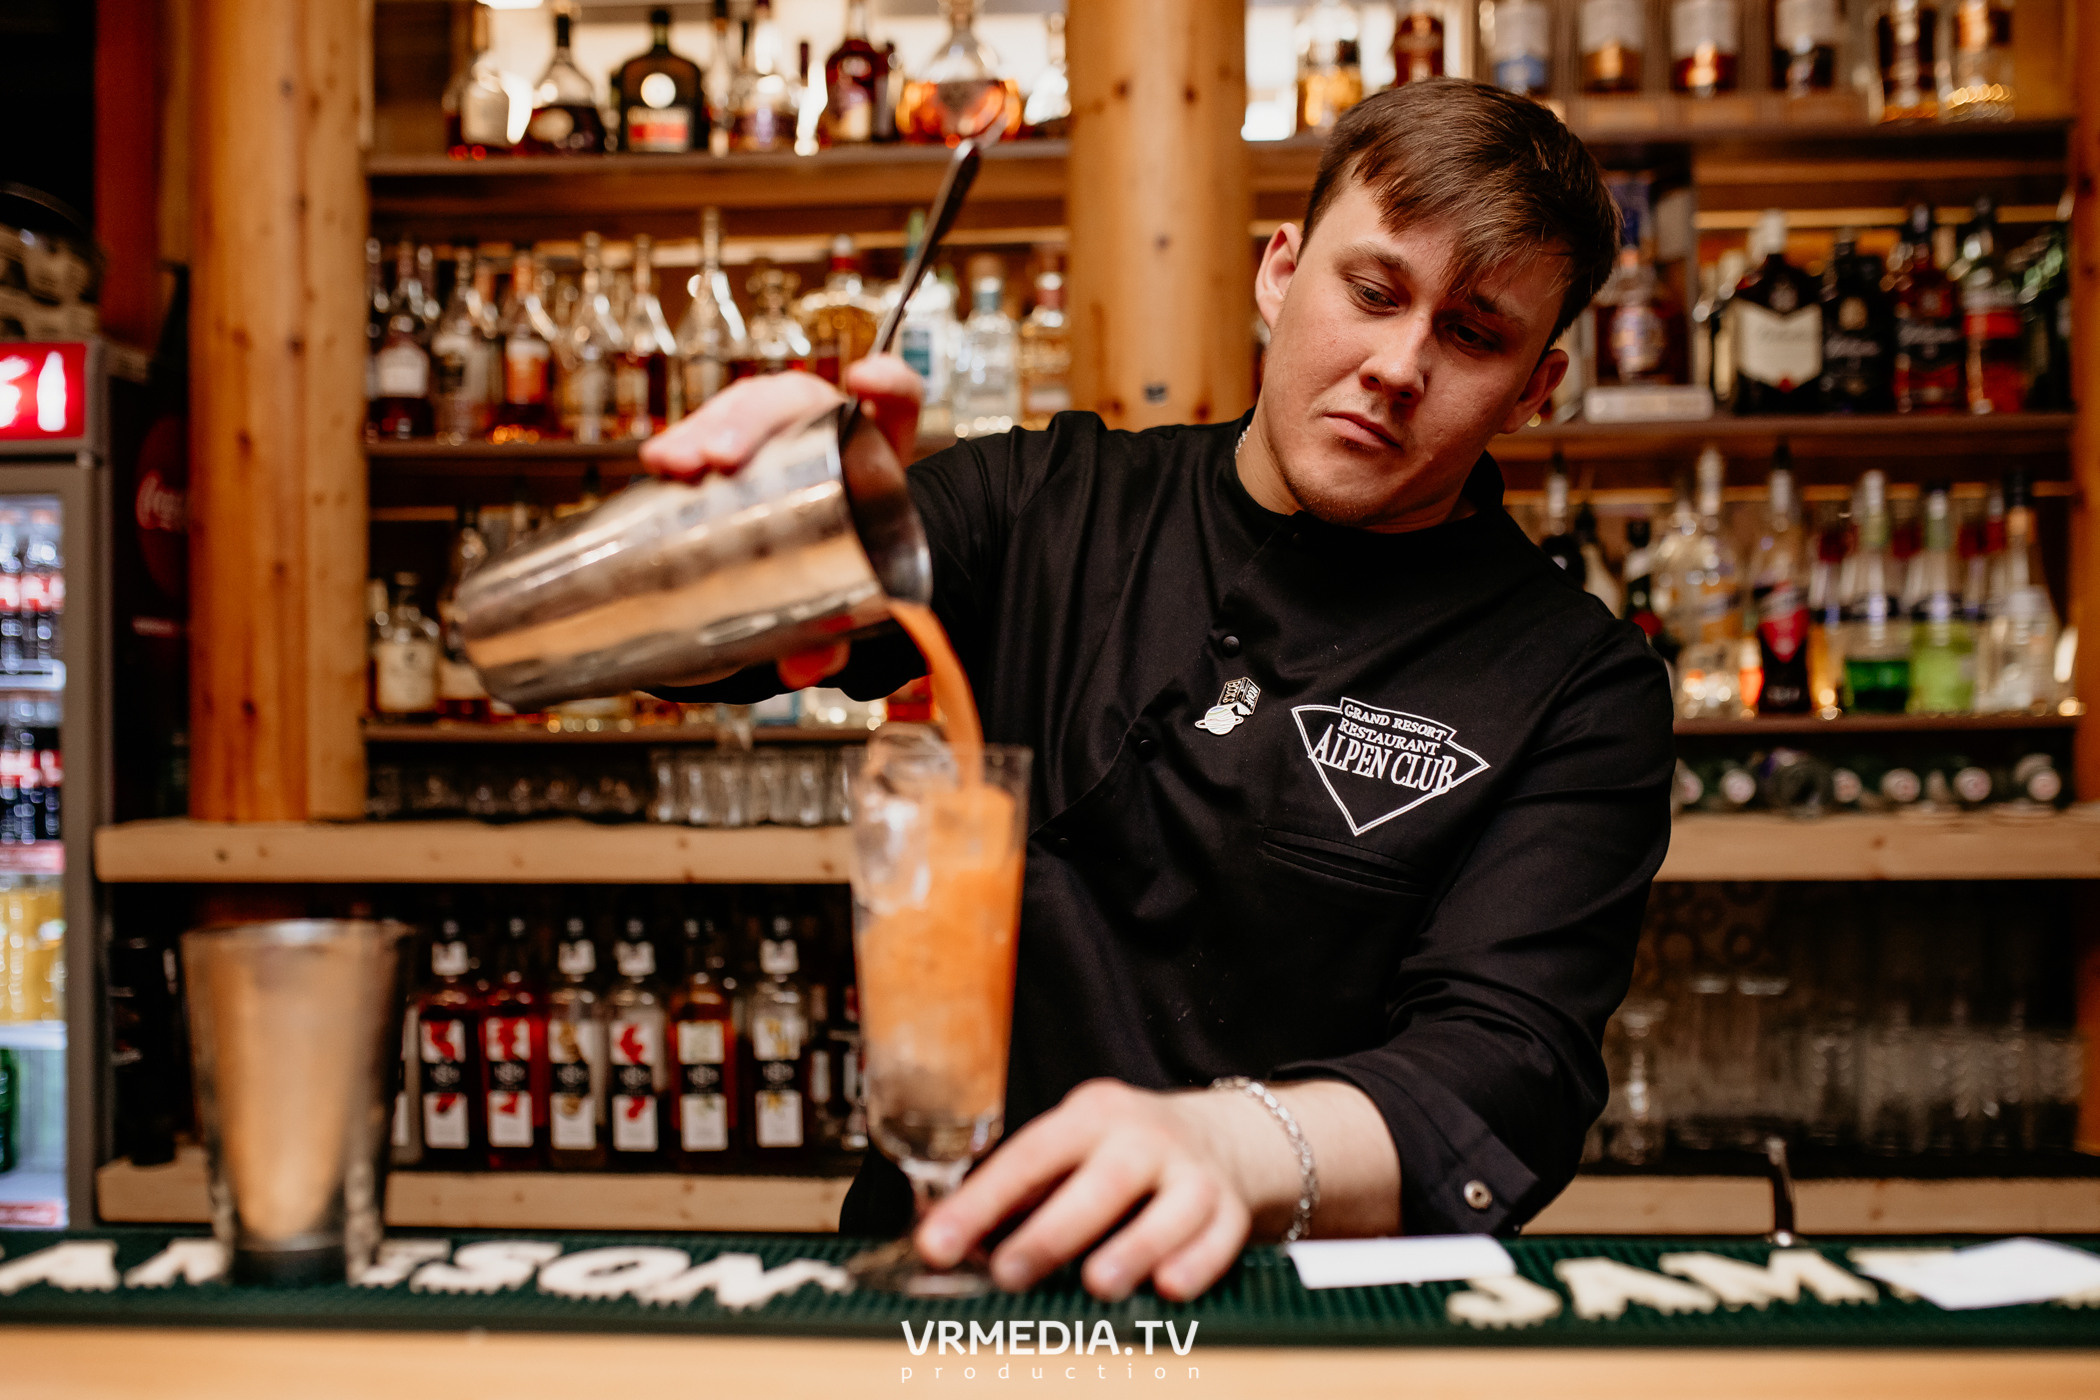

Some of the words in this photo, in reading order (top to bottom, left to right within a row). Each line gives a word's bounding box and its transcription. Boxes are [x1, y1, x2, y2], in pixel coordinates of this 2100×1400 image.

[1337, 717, 1441, 757] RESTAURANT
[1344, 703, 1390, 727] GRAND
[1392, 716, 1447, 742] RESORT
[1309, 723, 1393, 780] ALPEN
[1390, 752, 1458, 795] CLUB
